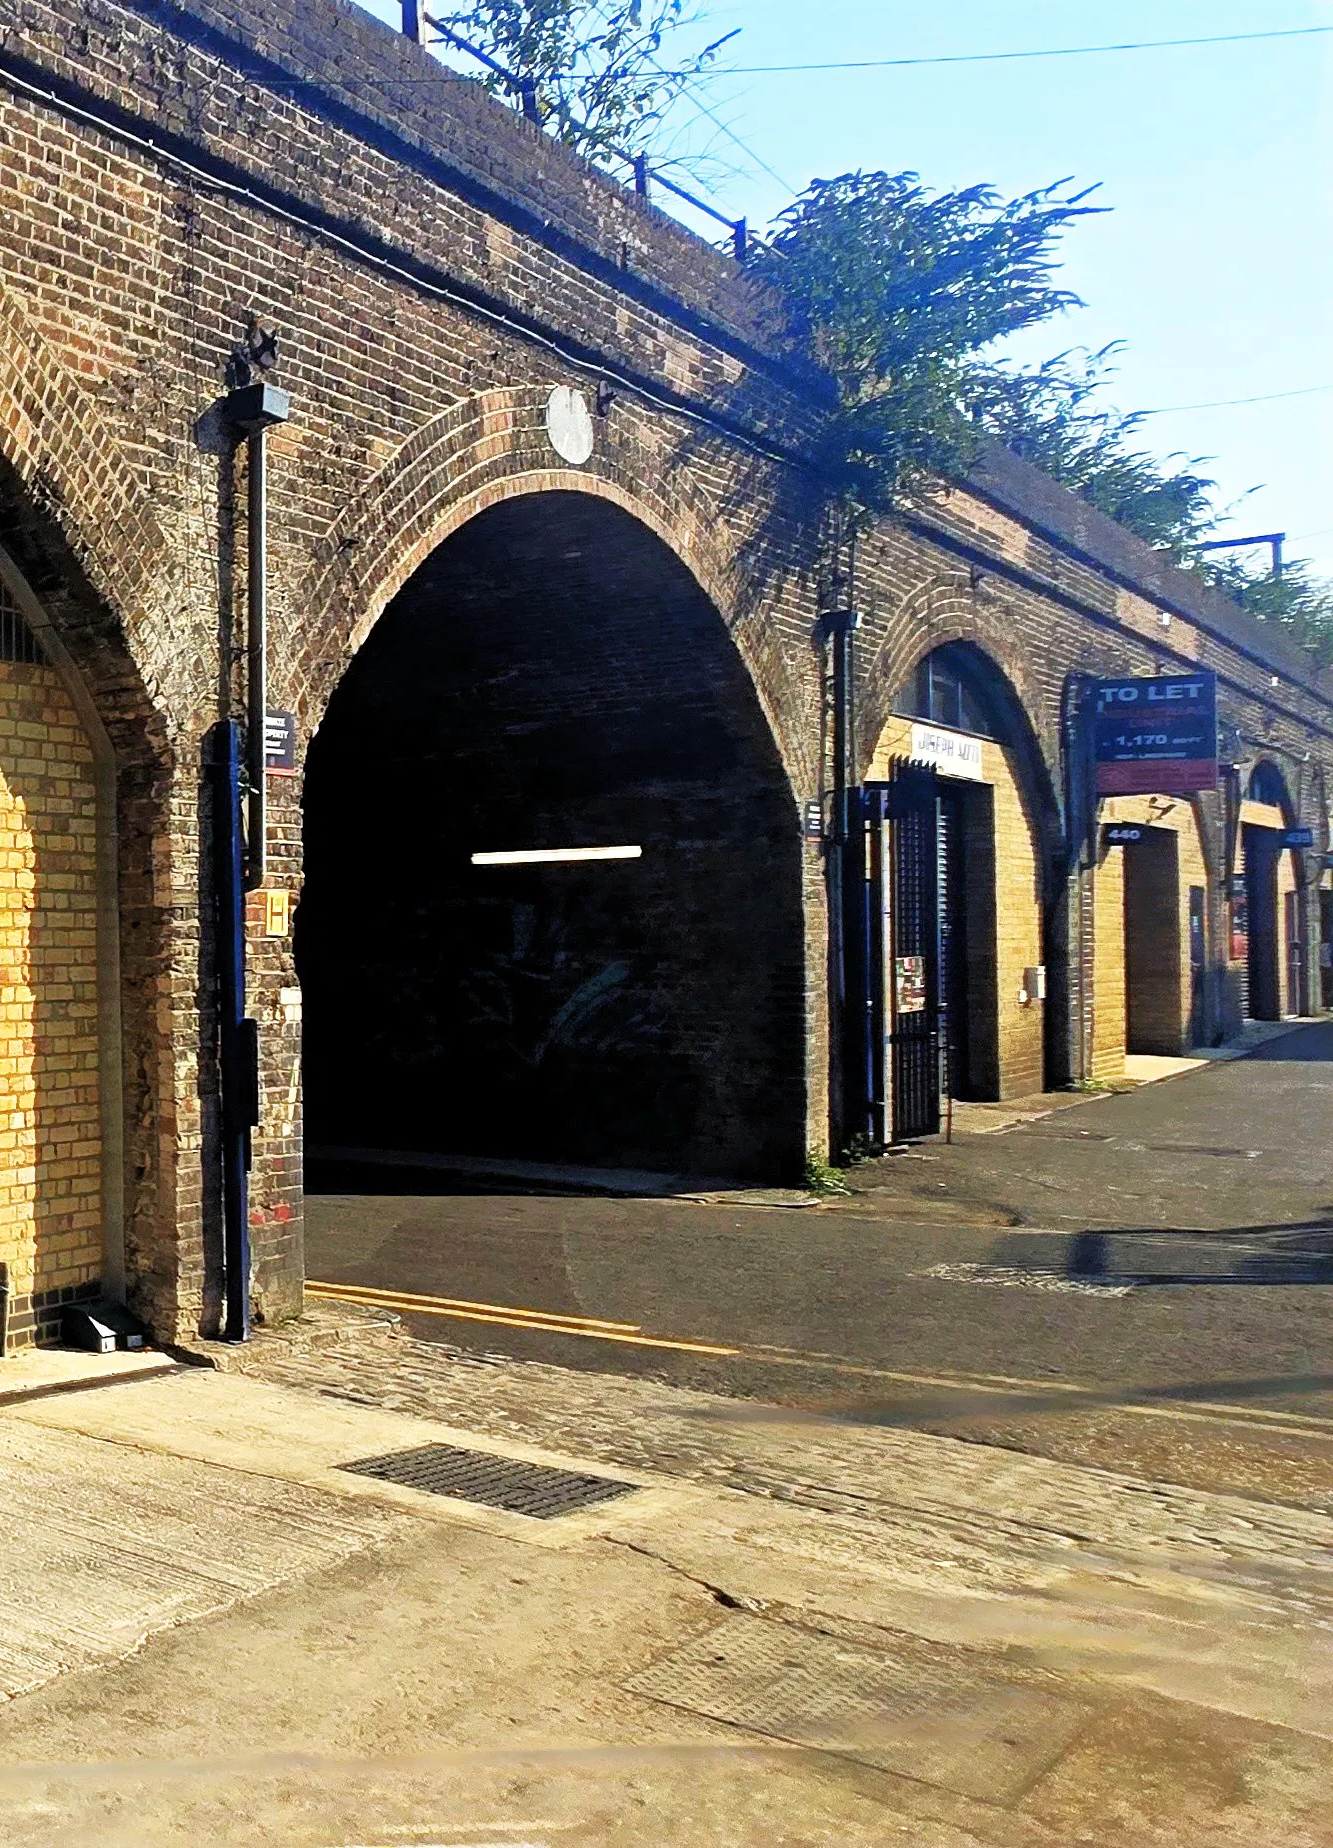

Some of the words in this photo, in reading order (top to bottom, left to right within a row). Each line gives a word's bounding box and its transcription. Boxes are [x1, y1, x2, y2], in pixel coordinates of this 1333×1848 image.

[1099, 687, 1139, 702] TO
[1147, 683, 1204, 700] LET
[1116, 734, 1168, 748] 1,170
[1108, 829, 1141, 840] 440
